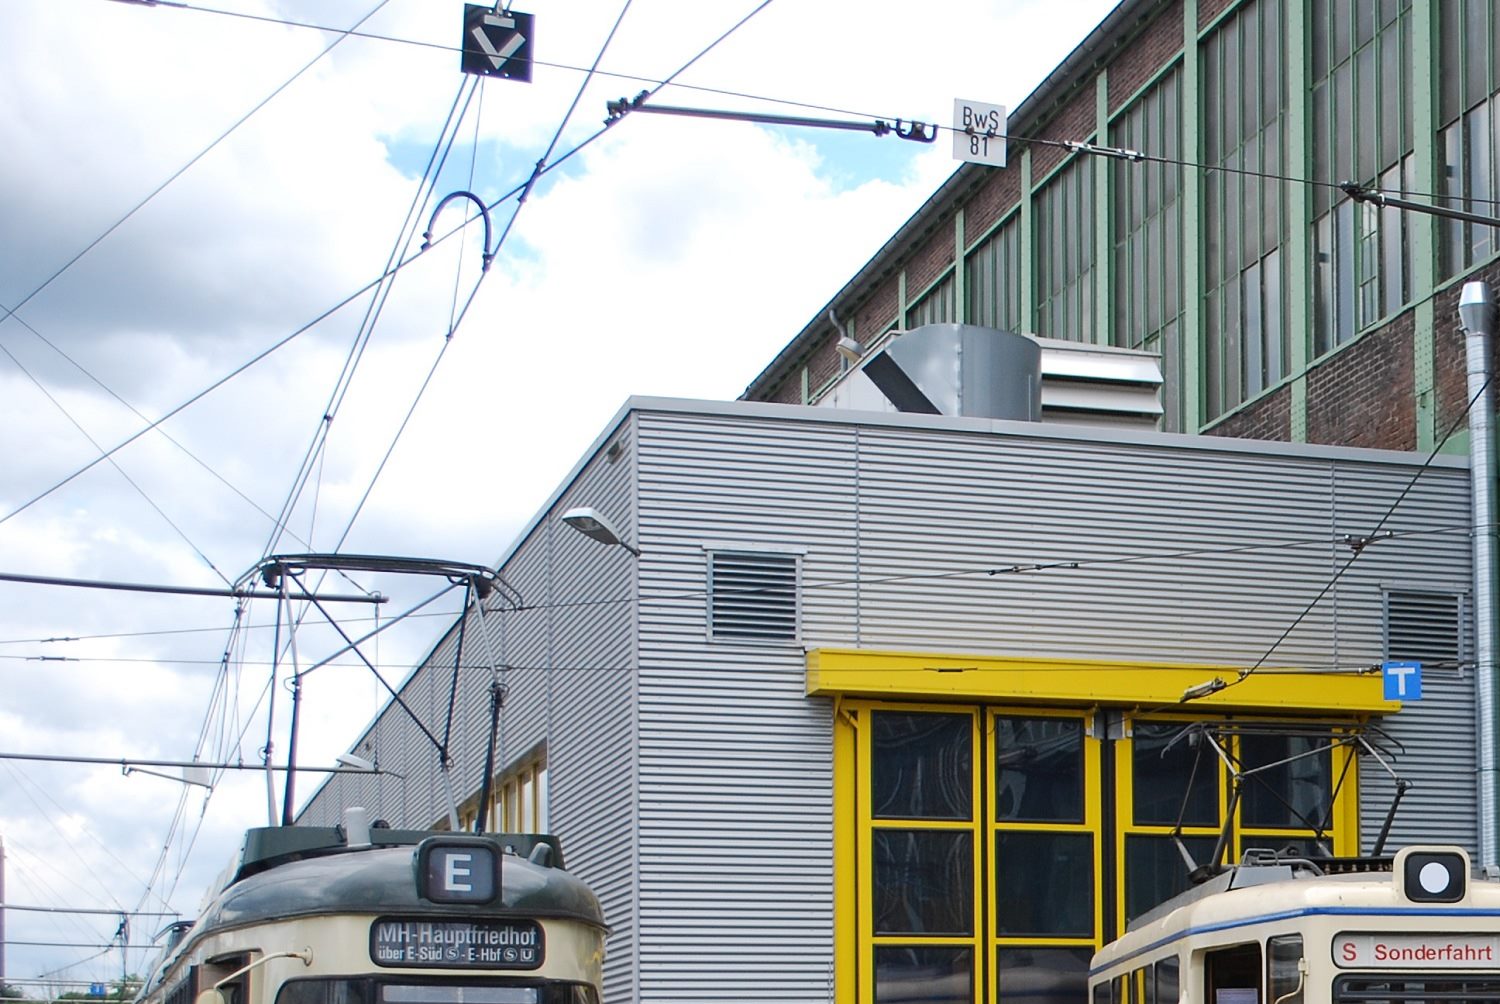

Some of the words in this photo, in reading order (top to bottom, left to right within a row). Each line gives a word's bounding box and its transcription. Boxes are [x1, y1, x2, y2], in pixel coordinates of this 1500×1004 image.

[963, 106, 999, 131] BwS
[970, 135, 988, 157] 81
[1387, 667, 1416, 696] T
[445, 853, 472, 892] E
[379, 923, 537, 947] MH-Hauptfriedhof
[378, 945, 405, 960] über
[407, 946, 443, 961] E-Süd
[468, 947, 502, 962] E-Hbf
[1343, 943, 1357, 961] S
[1375, 944, 1493, 961] Sonderfahrt
